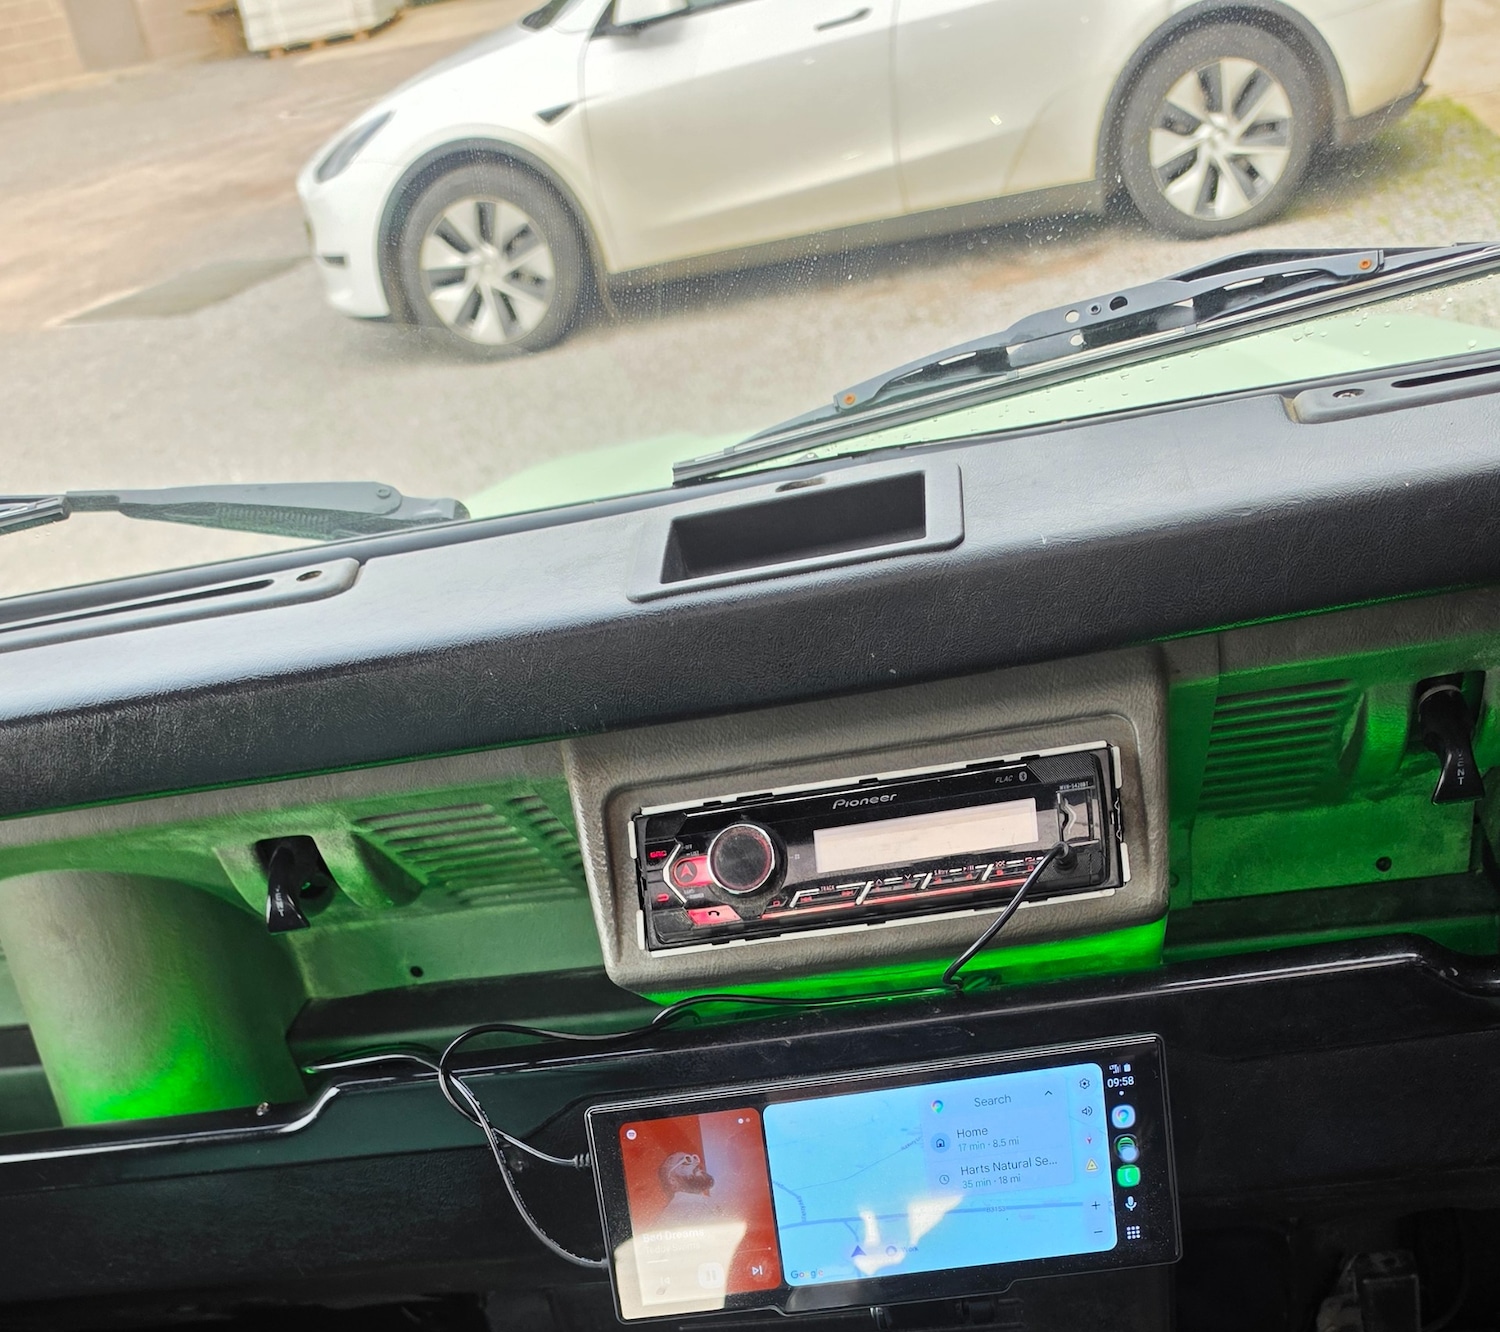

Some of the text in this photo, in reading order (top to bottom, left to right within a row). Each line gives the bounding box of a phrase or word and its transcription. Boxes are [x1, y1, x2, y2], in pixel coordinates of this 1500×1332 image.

[995, 774, 1013, 783] FLAC
[832, 793, 897, 810] Pioneer
[1107, 1076, 1134, 1088] 09:58
[974, 1094, 1011, 1108] Search
[957, 1127, 988, 1139] Home
[958, 1136, 1020, 1152] 17 min 8.5 mi
[960, 1164, 990, 1176] Harts
[993, 1158, 1031, 1172] Natural
[962, 1174, 1021, 1189] 35 min 18 mi
[790, 1268, 824, 1279] Google
